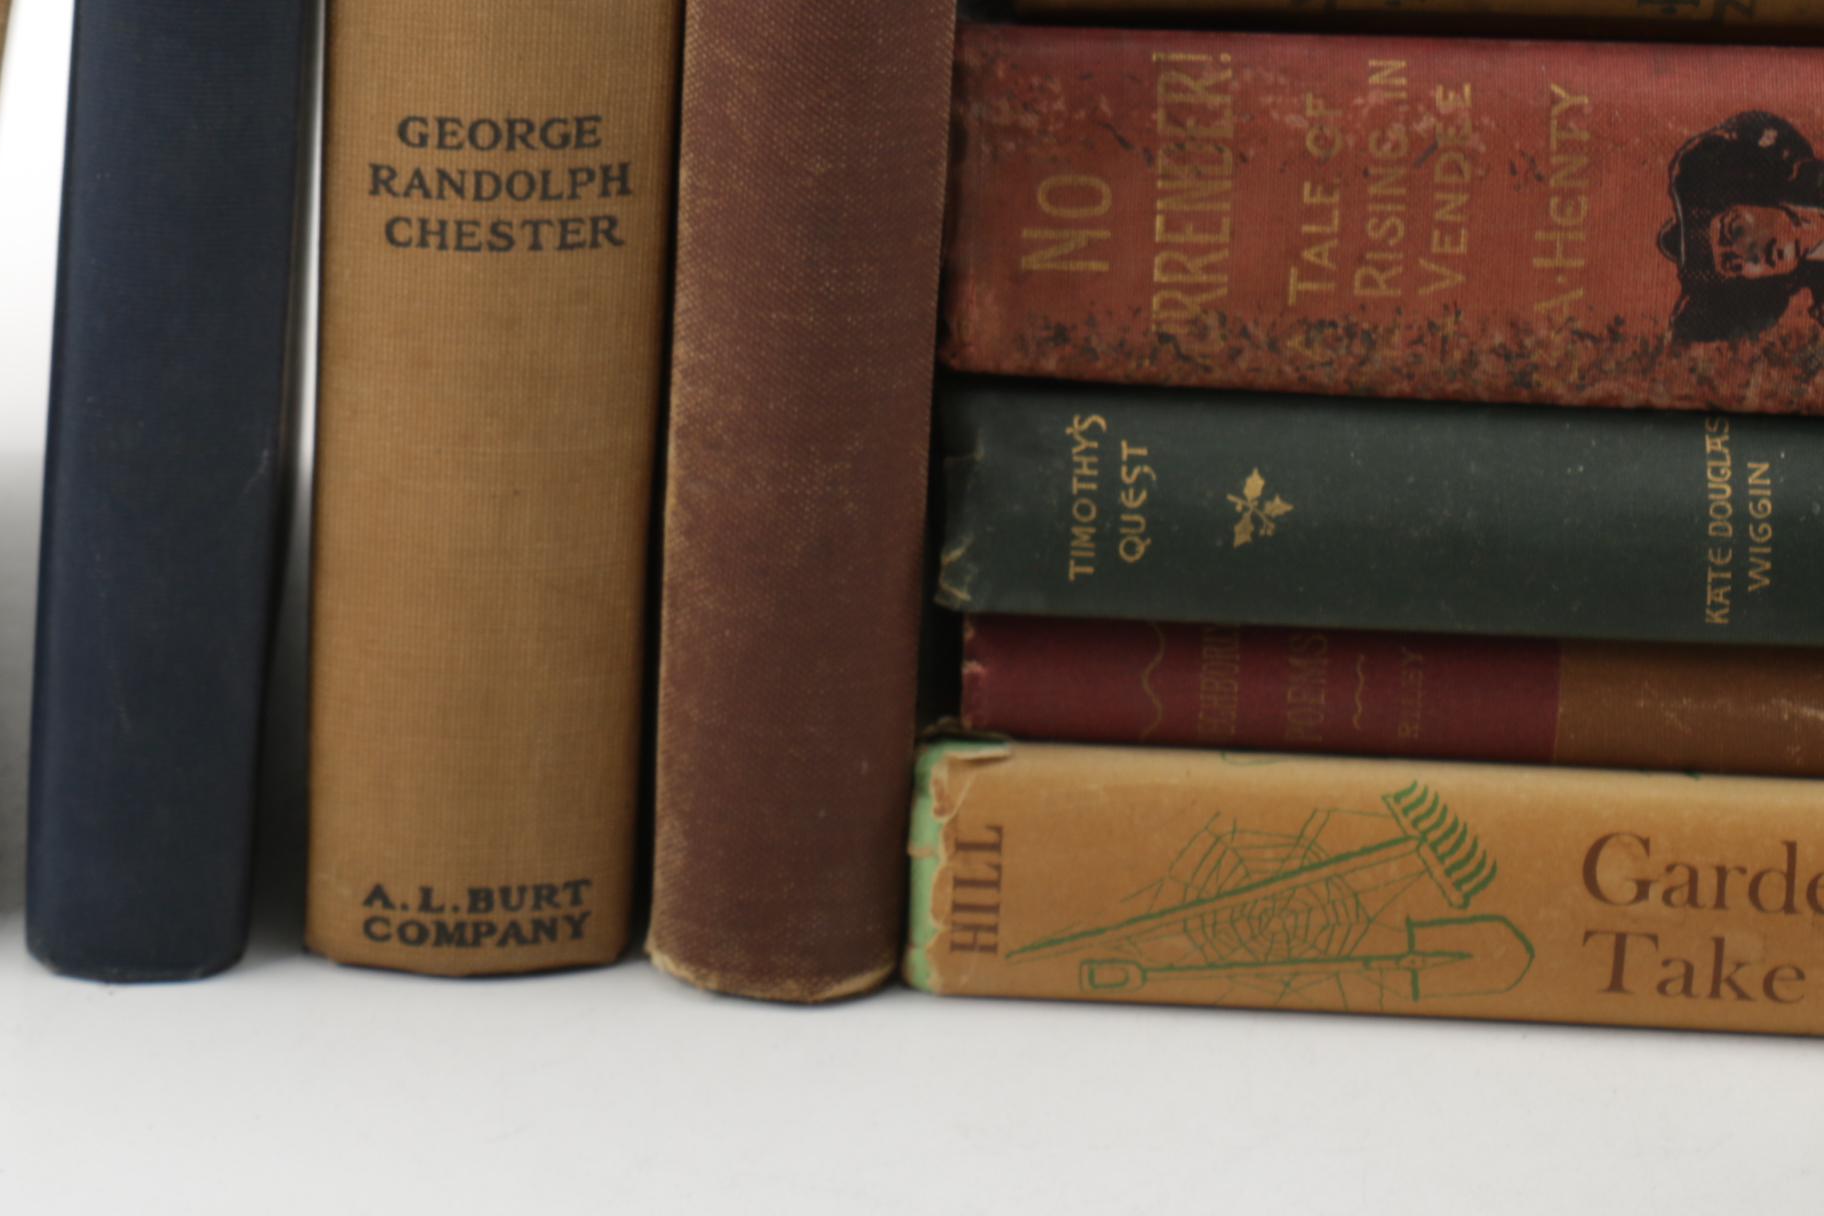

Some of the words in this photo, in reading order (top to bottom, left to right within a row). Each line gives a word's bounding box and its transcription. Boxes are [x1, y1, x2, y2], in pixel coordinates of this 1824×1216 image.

[397, 114, 604, 152] GEORGE
[368, 160, 633, 203] RANDOLPH
[384, 215, 626, 253] CHESTER
[1021, 175, 1113, 271] NO
[1288, 180, 1340, 307] TALE
[1118, 439, 1157, 564] QUEST
[1747, 461, 1774, 592] WIGGIN
[1706, 547, 1733, 625] KATE
[949, 824, 1004, 956] HILL
[362, 910, 593, 949] COMPANY
[1581, 929, 1808, 1005] Take
